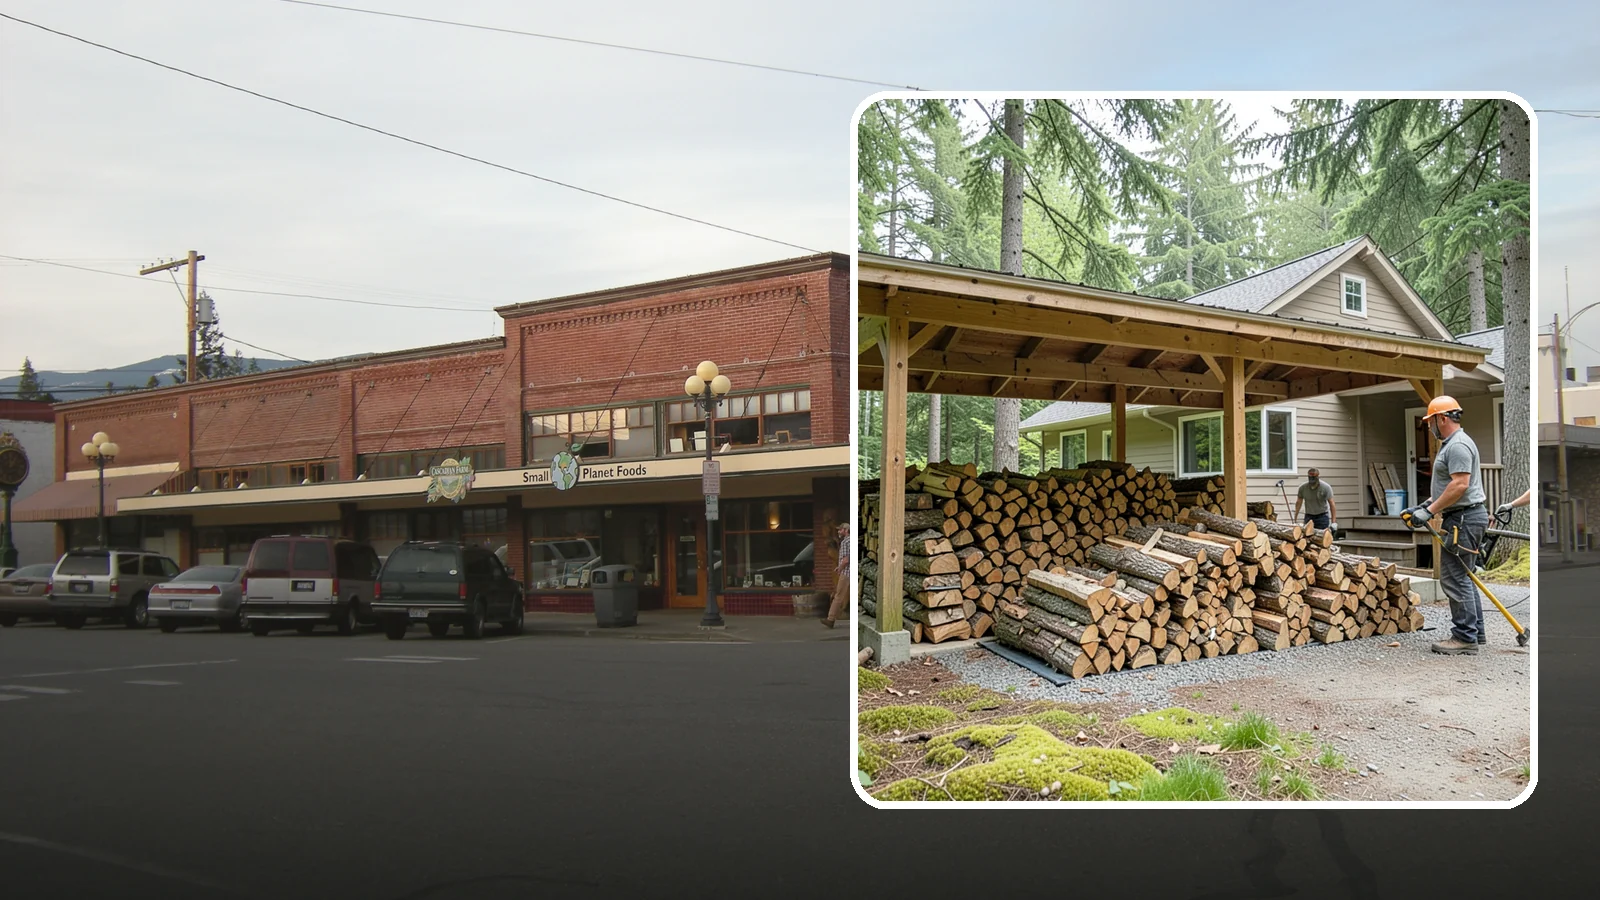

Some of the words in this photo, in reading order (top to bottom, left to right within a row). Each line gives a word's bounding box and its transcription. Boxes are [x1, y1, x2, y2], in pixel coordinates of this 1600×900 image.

[523, 471, 549, 483] Small
[583, 467, 614, 479] Planet
[617, 464, 647, 477] Foods
